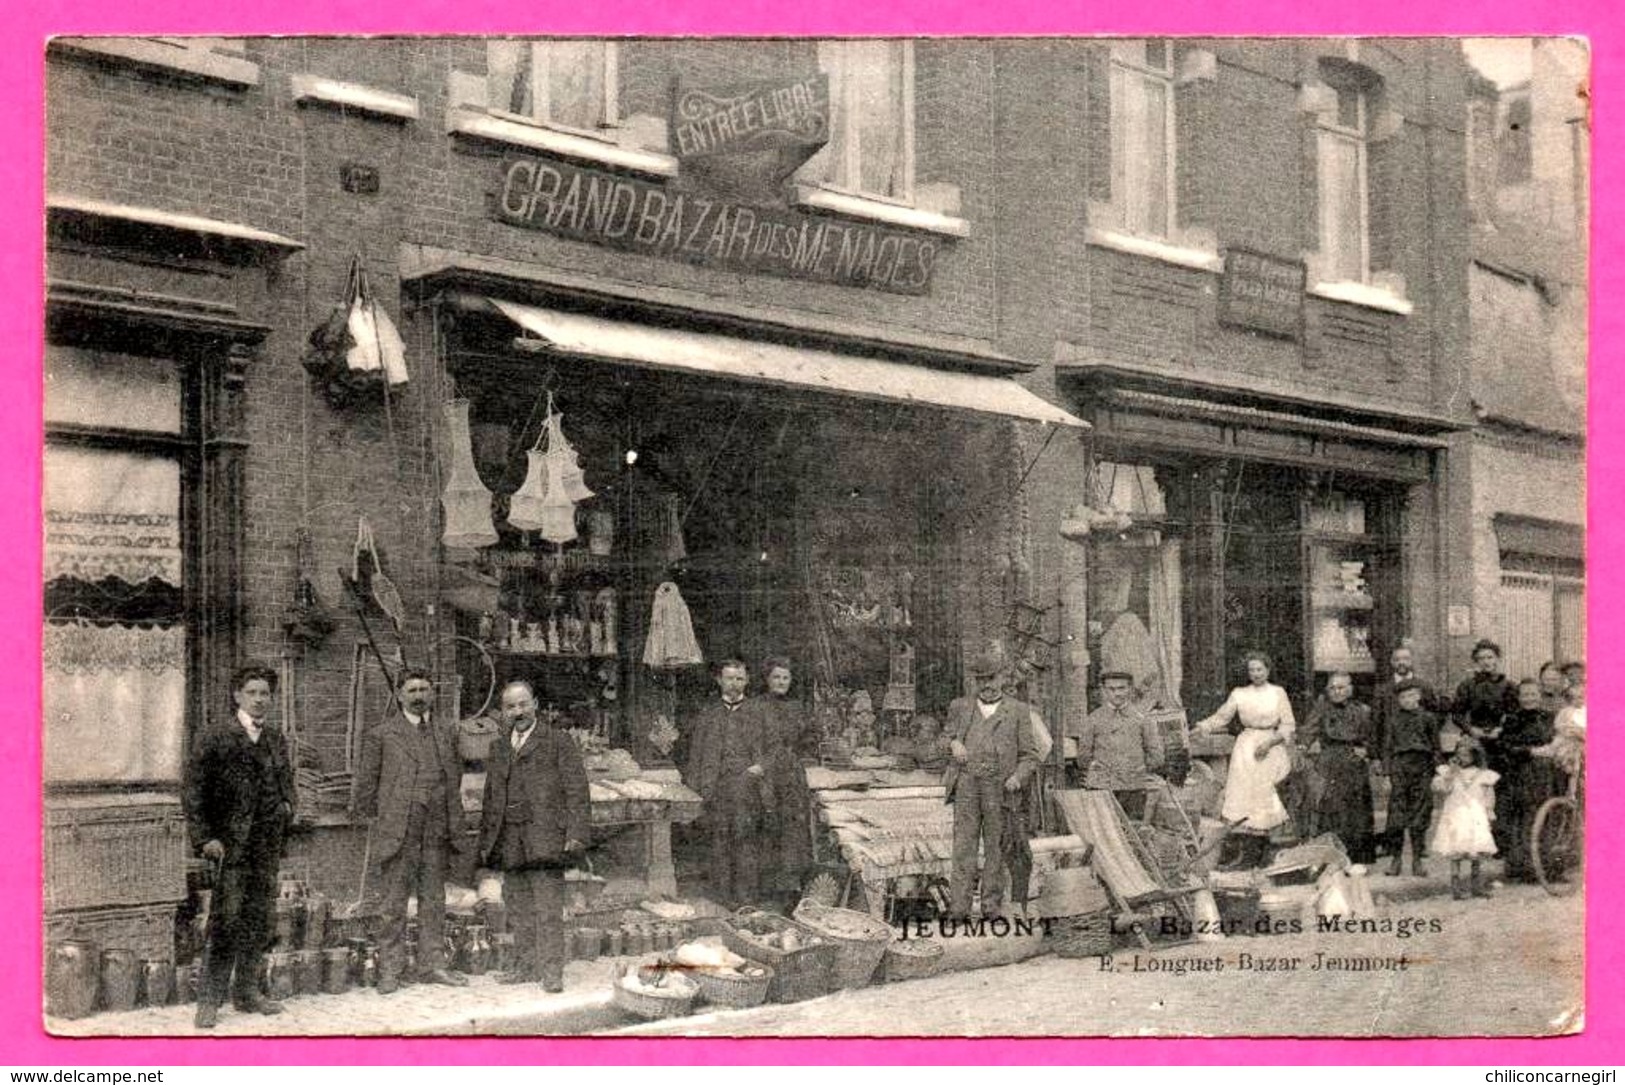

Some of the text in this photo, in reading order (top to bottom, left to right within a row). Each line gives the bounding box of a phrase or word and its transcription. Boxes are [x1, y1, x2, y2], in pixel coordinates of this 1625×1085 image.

[502, 160, 636, 237] GRAND
[634, 190, 755, 261] BAZAR
[754, 221, 798, 260] DES
